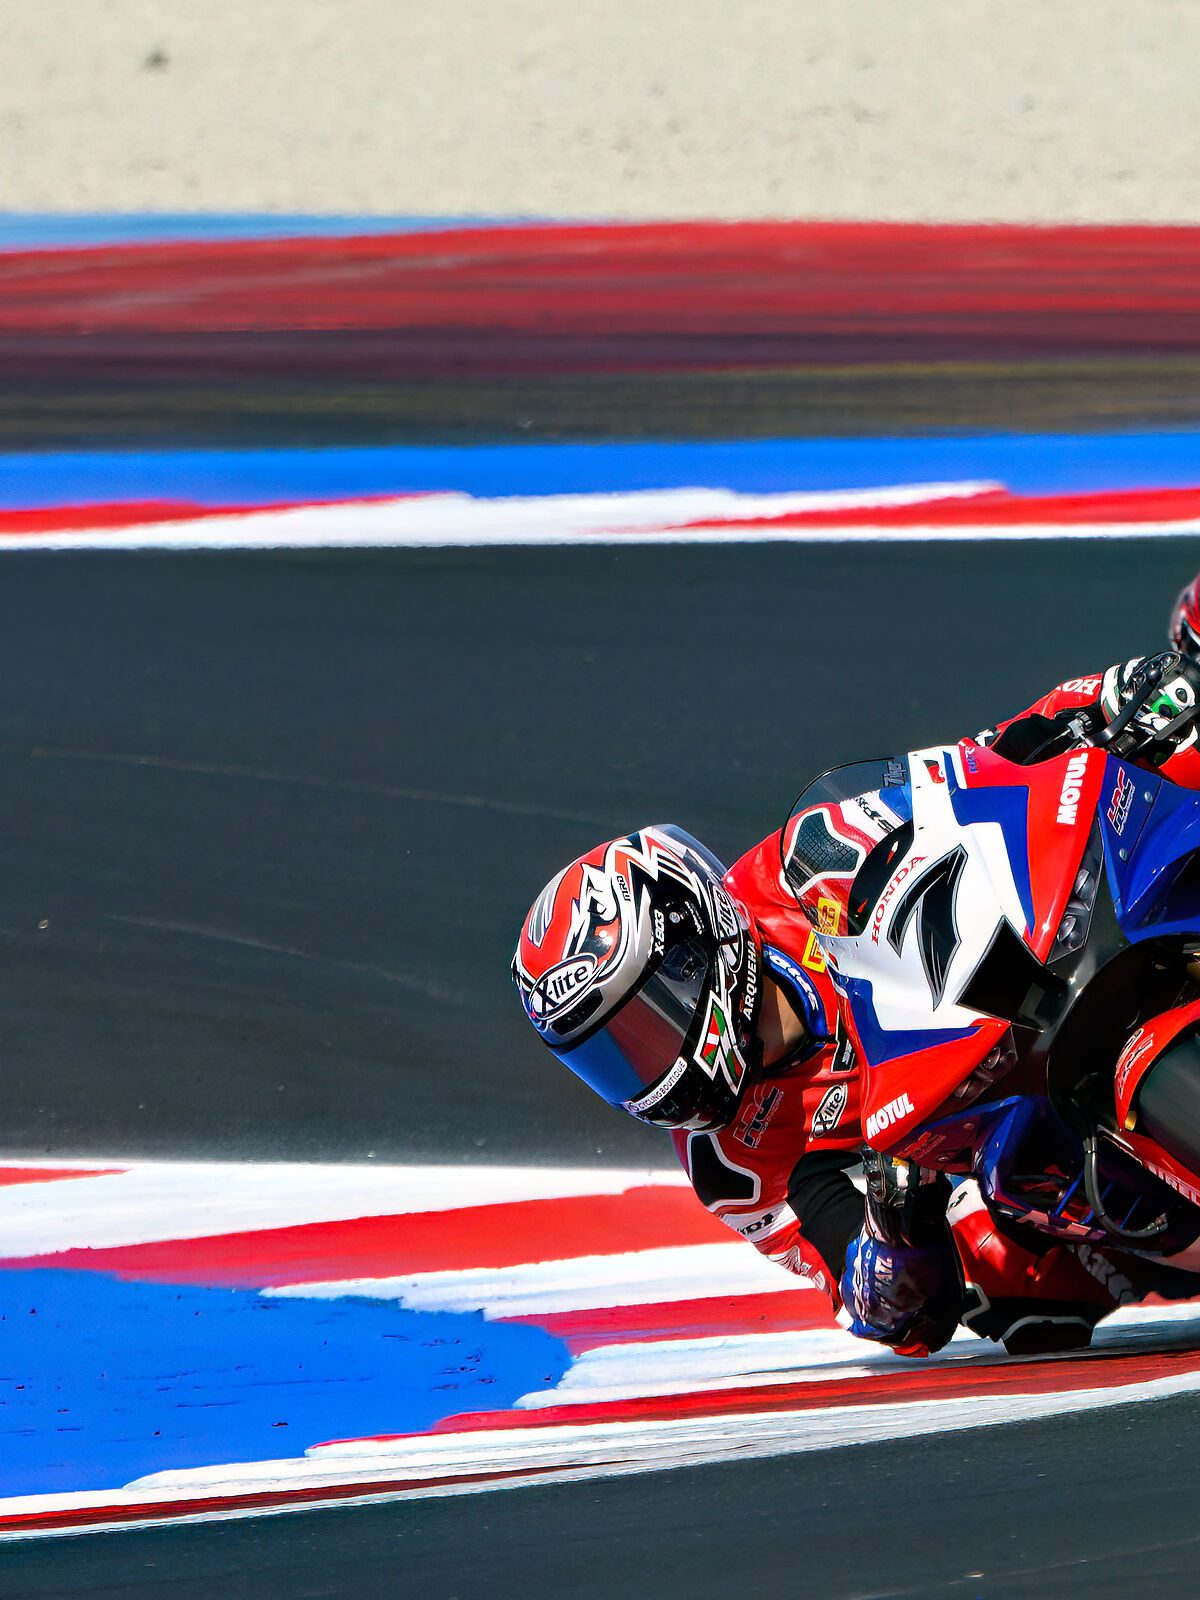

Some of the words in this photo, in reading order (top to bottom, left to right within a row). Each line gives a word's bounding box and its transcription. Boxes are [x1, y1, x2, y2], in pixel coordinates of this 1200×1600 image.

[1056, 752, 1089, 825] MOTUL
[870, 855, 928, 946] HONDA
[886, 843, 969, 1012] 7
[536, 963, 589, 1014] X-lite
[815, 1091, 843, 1133] X-lite
[866, 1093, 915, 1139] MOTUL
